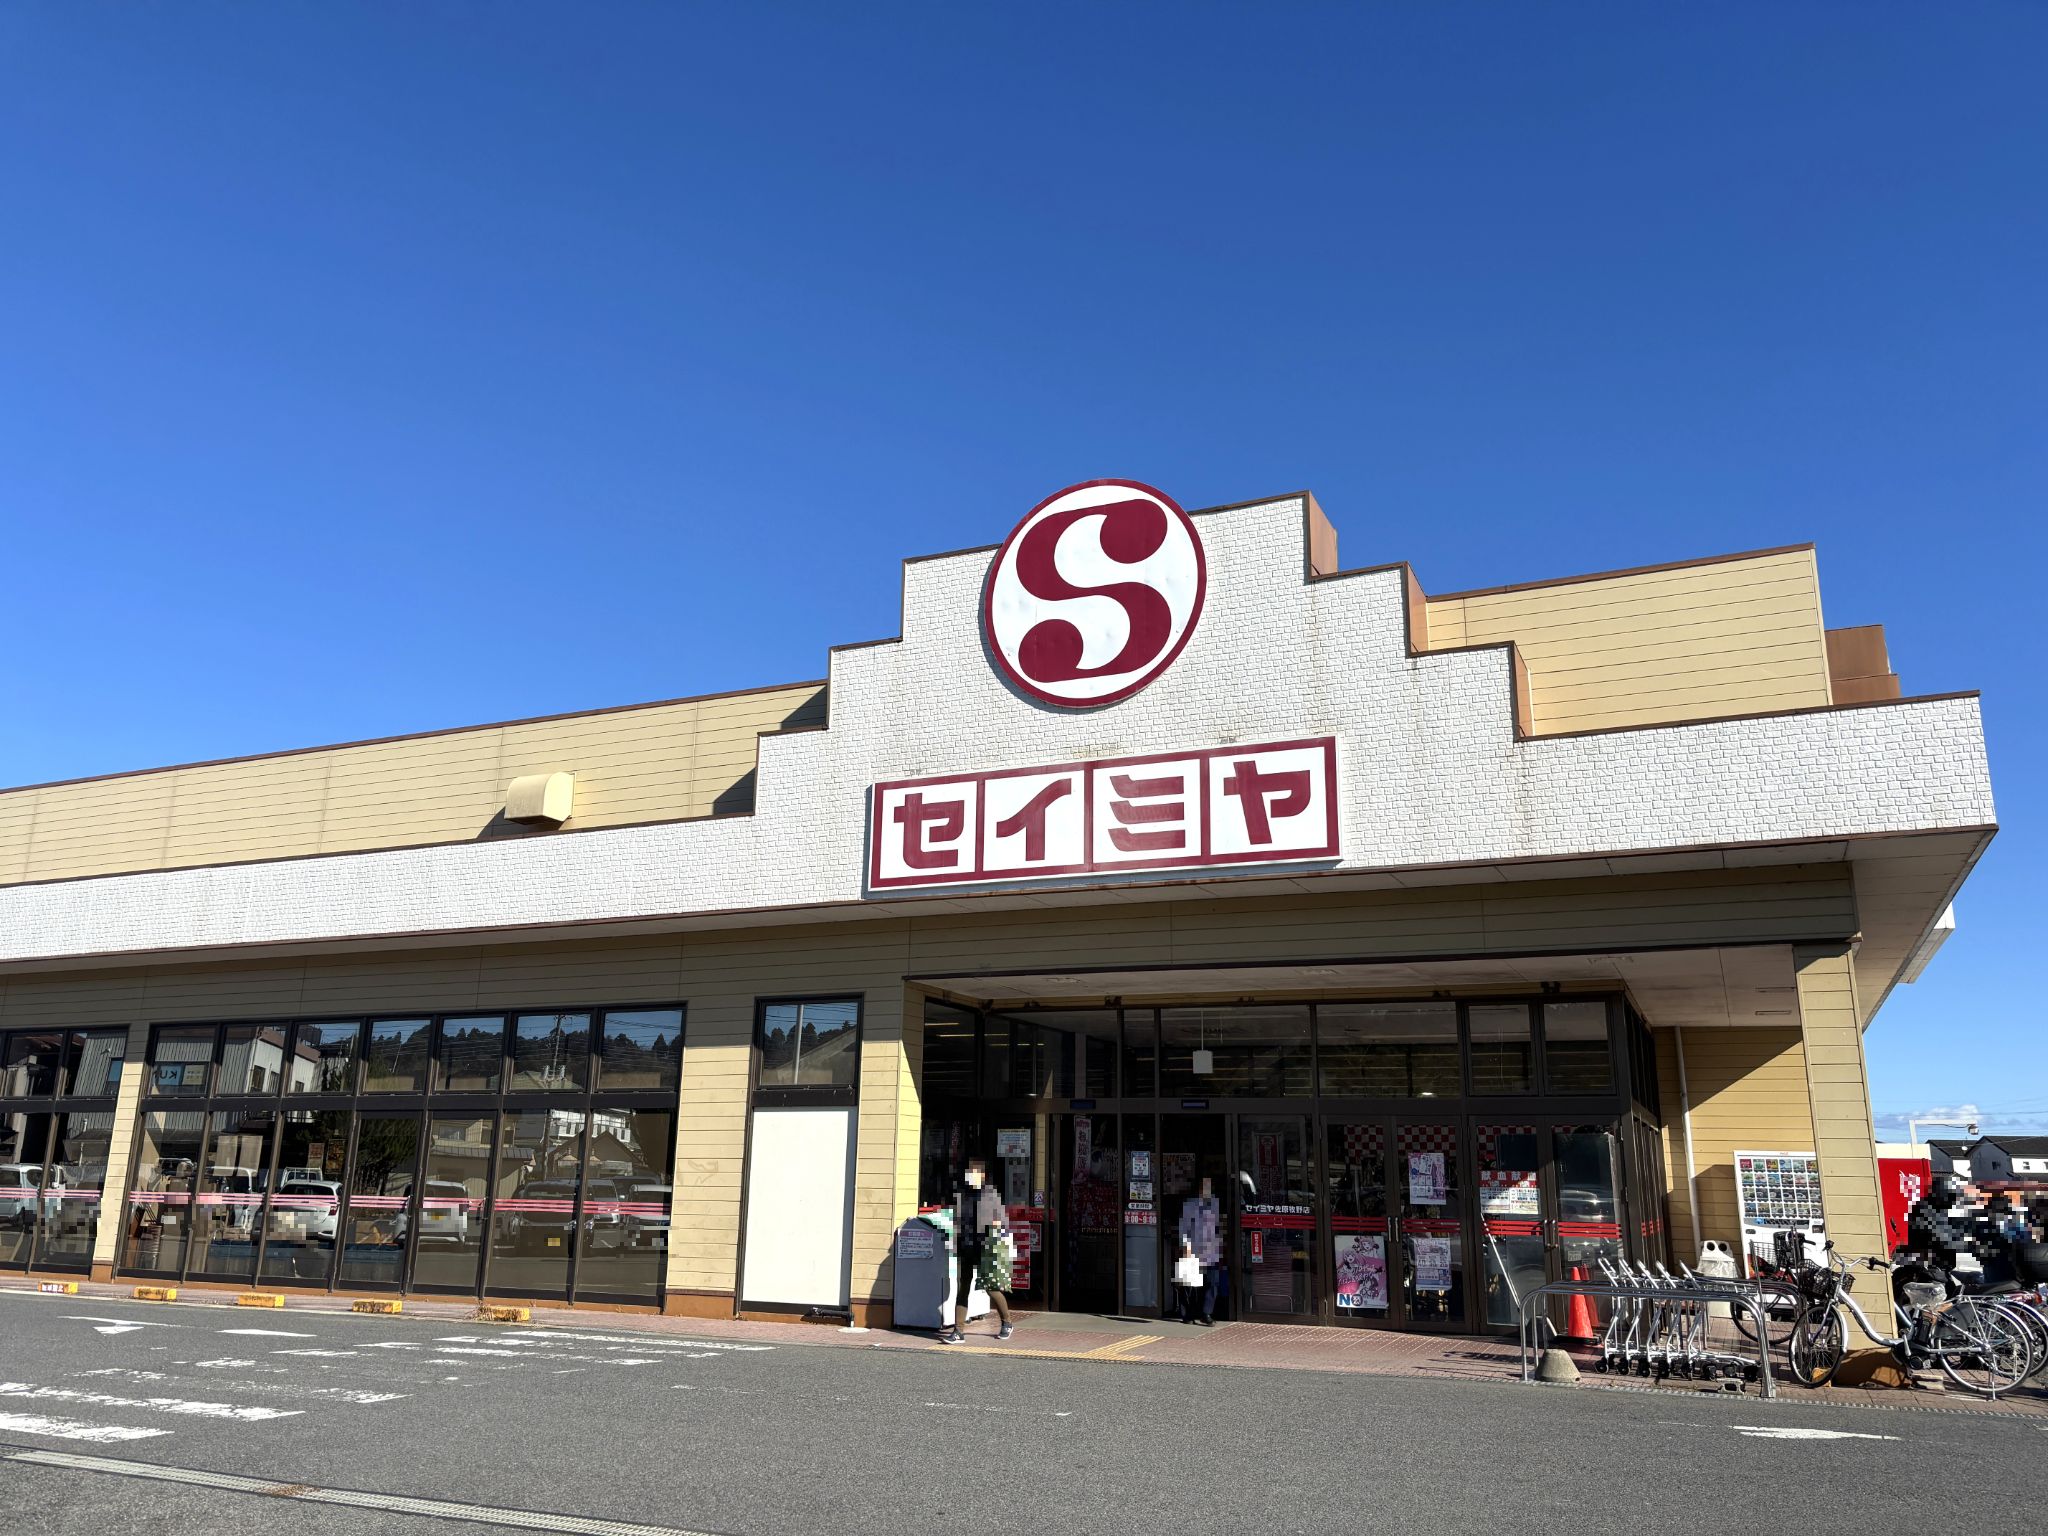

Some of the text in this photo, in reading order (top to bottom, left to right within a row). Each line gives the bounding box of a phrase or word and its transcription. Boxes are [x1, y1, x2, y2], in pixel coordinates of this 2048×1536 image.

[1015, 498, 1172, 683] S
[893, 760, 1311, 870] セイミヤ
[1245, 1204, 1311, 1214] セイミヤ佐原牧野店
